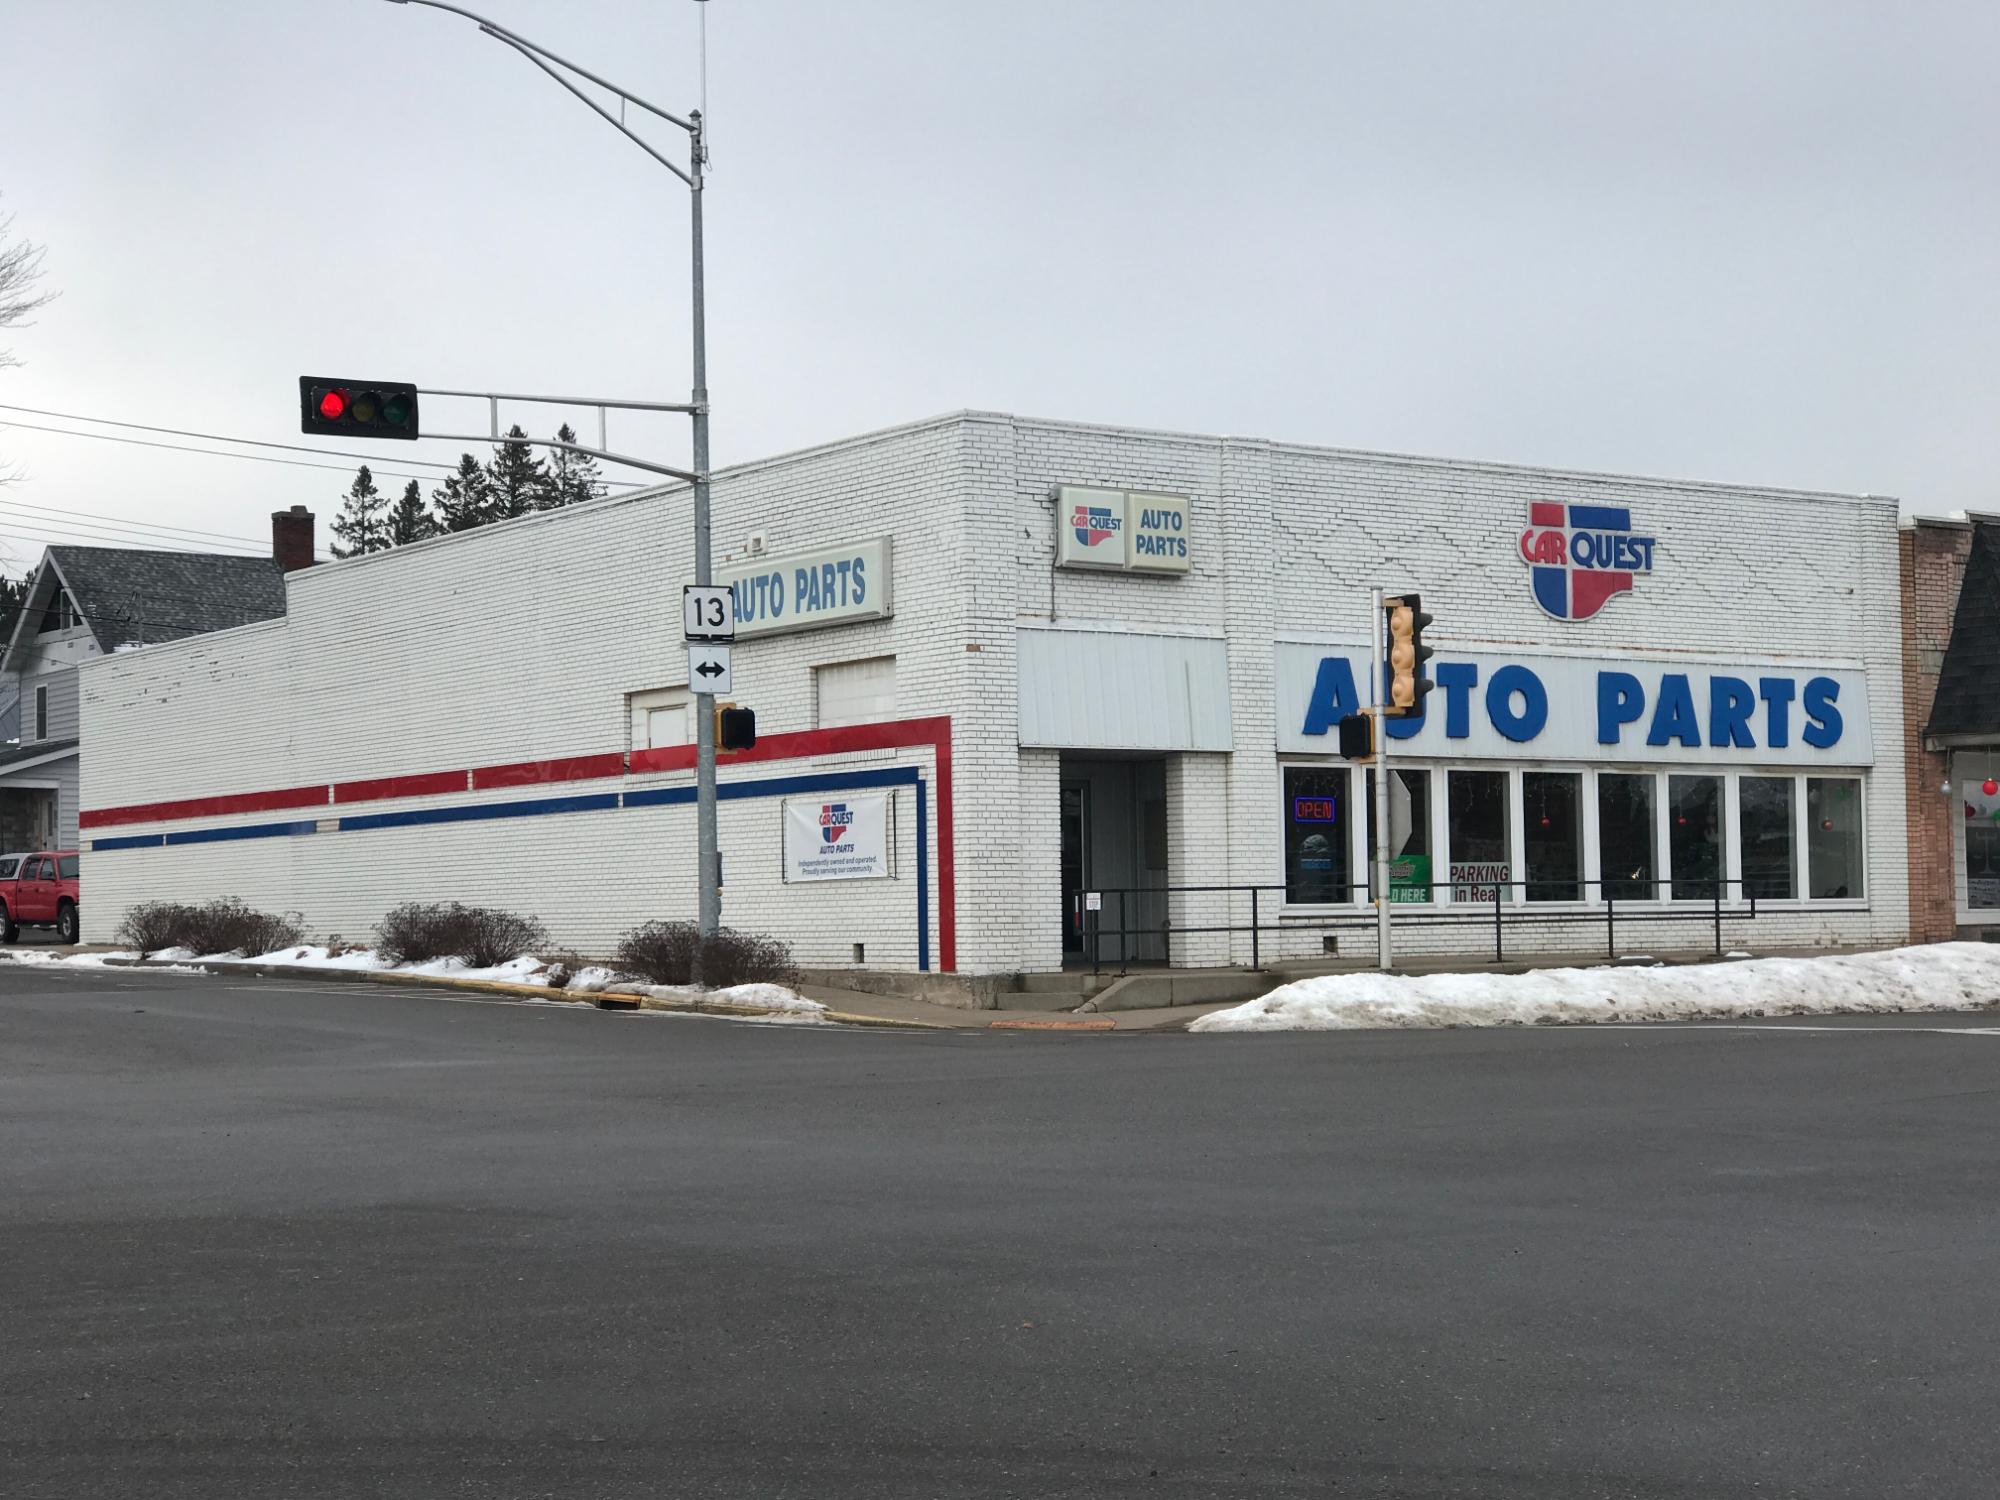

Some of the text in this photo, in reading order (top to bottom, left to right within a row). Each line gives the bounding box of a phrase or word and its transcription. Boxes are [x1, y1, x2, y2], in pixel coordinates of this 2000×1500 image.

[1141, 509, 1182, 531] AUTO
[1136, 534, 1187, 557] PARTS
[732, 557, 865, 623] AUTO PARTS
[694, 597, 725, 627] 13
[1597, 671, 1843, 748] PARTS
[1297, 801, 1332, 818] OPEN
[819, 844, 854, 854] AUTO PARTS
[846, 857, 854, 865] and
[802, 867, 819, 876] Proudly
[1450, 865, 1509, 882] PARKING
[1401, 888, 1426, 902] HERE
[1455, 883, 1501, 902] in Rea
